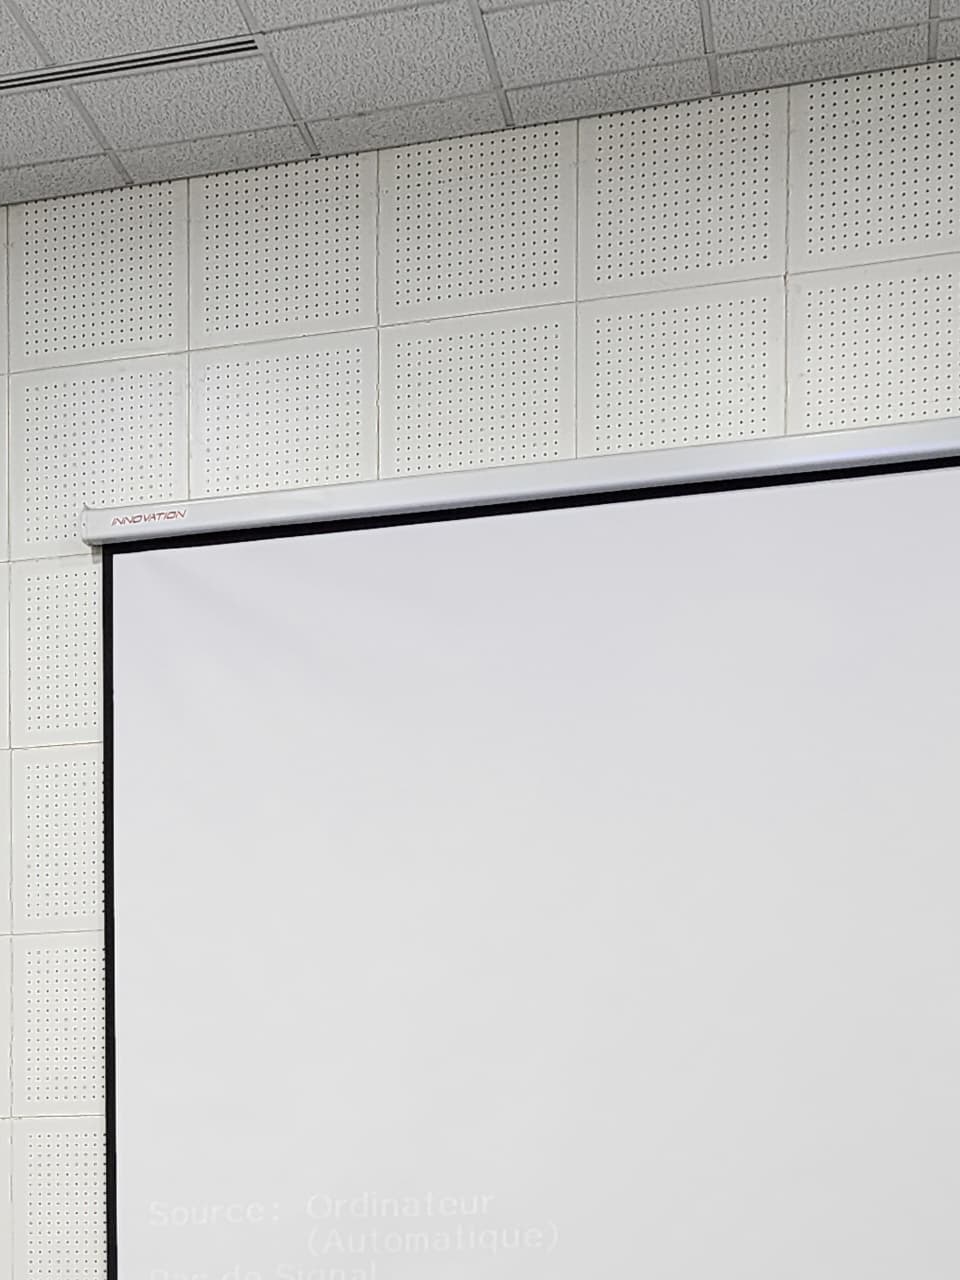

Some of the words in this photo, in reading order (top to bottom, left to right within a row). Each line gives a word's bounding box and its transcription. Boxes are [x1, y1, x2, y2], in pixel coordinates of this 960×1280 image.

[111, 509, 187, 526] INNOVATION
[148, 1200, 281, 1226] Source:
[304, 1192, 496, 1219] Ordinateur
[306, 1223, 560, 1257] (Automatique)
